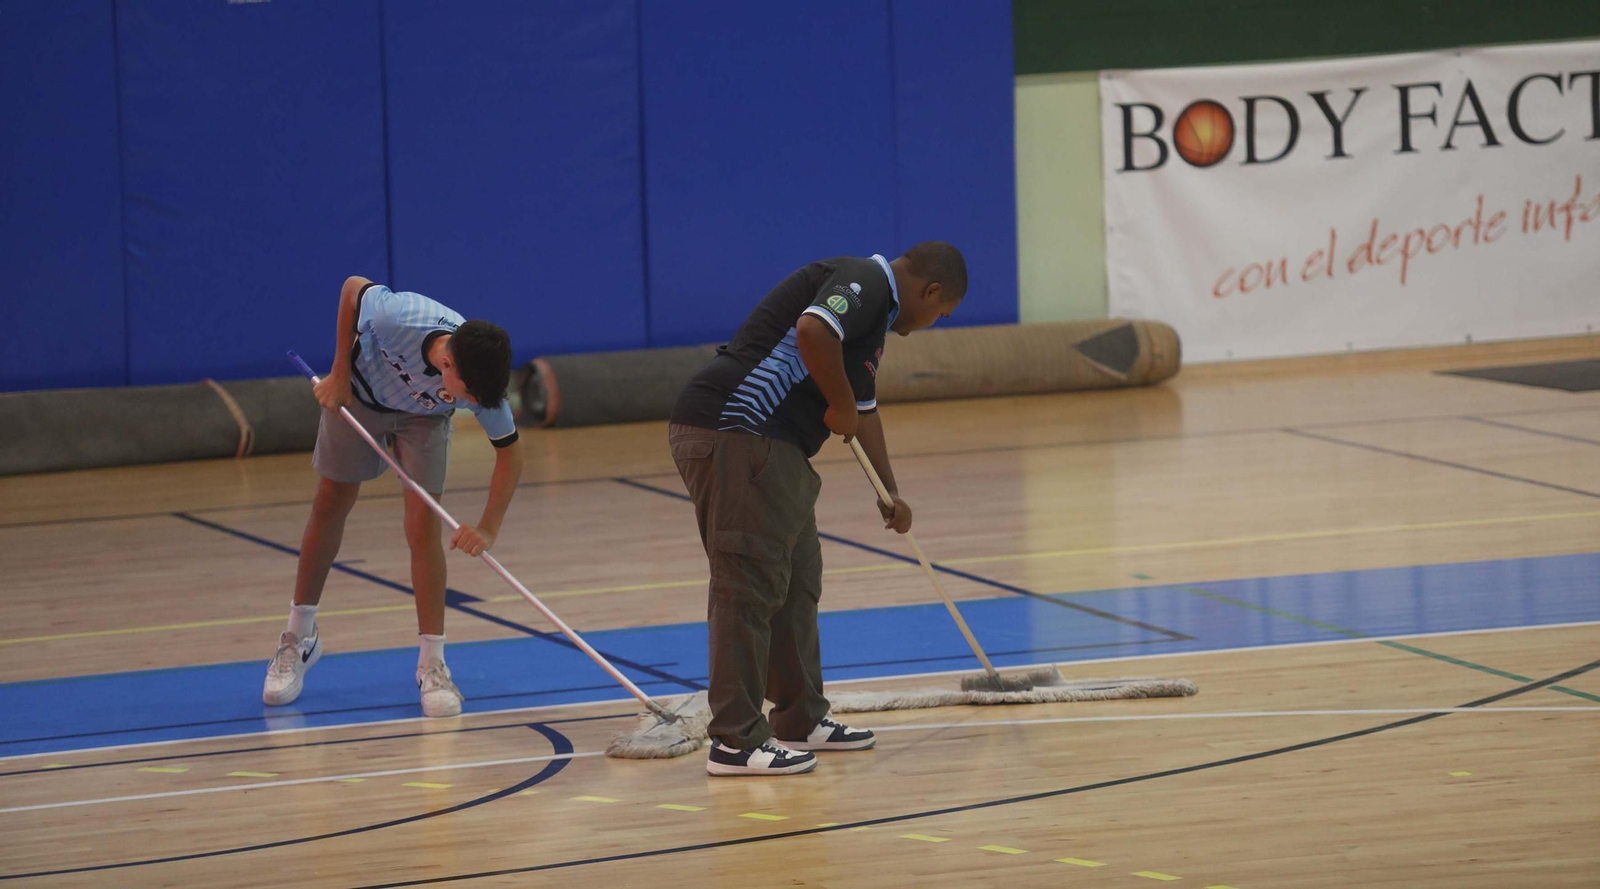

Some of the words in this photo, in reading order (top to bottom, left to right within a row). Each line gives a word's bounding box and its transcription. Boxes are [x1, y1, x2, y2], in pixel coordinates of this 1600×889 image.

[1114, 87, 1368, 172] BODY
[1392, 71, 1600, 155] FACT
[1213, 254, 1290, 300] con
[1300, 228, 1337, 282] el
[1347, 193, 1507, 286] deporte
